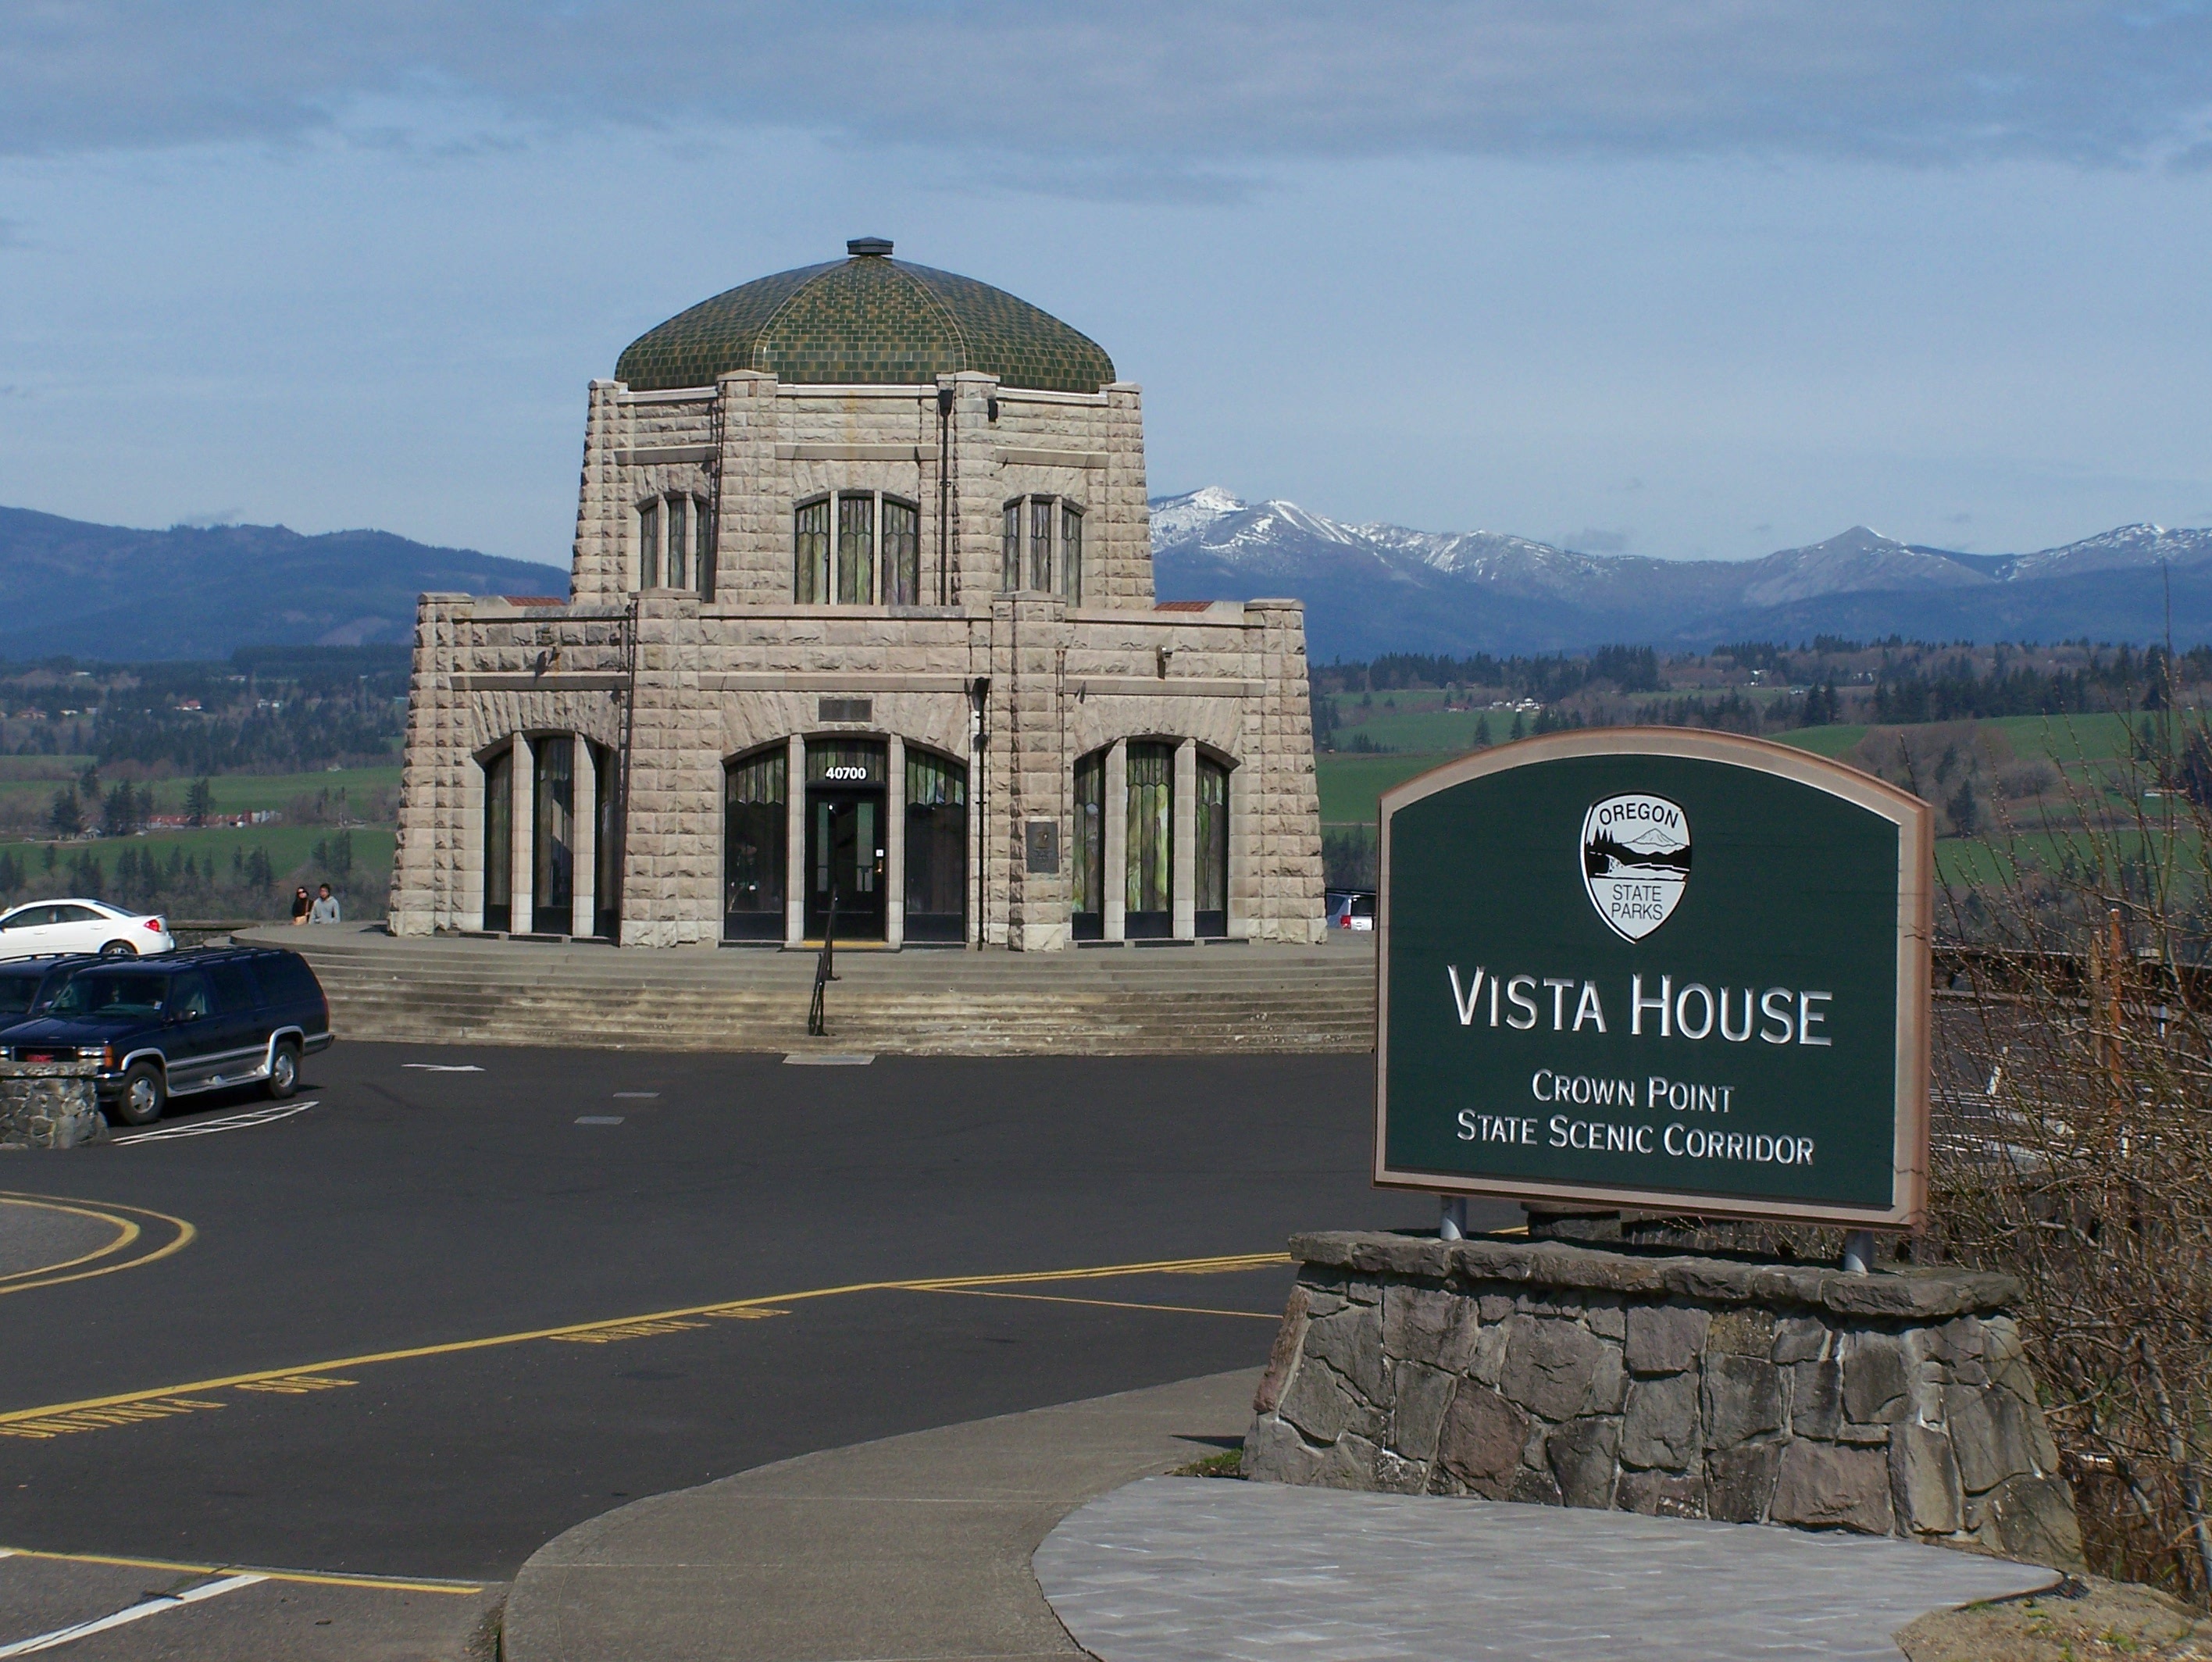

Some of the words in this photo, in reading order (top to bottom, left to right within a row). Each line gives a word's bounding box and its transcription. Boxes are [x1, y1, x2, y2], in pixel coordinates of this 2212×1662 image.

[826, 767, 867, 779] 40700
[1599, 802, 1679, 829] OREGON
[1612, 883, 1662, 902] STATE
[1611, 902, 1663, 921] PARKS
[1447, 965, 1607, 1033] VISTA
[1631, 973, 1833, 1047] HOUSE
[1532, 1068, 1636, 1107] CROWN
[1648, 1076, 1735, 1113] POINT
[1457, 1109, 1538, 1145] STATE
[1549, 1115, 1654, 1154] SCENIC
[1664, 1122, 1814, 1166] CORRIDOR
